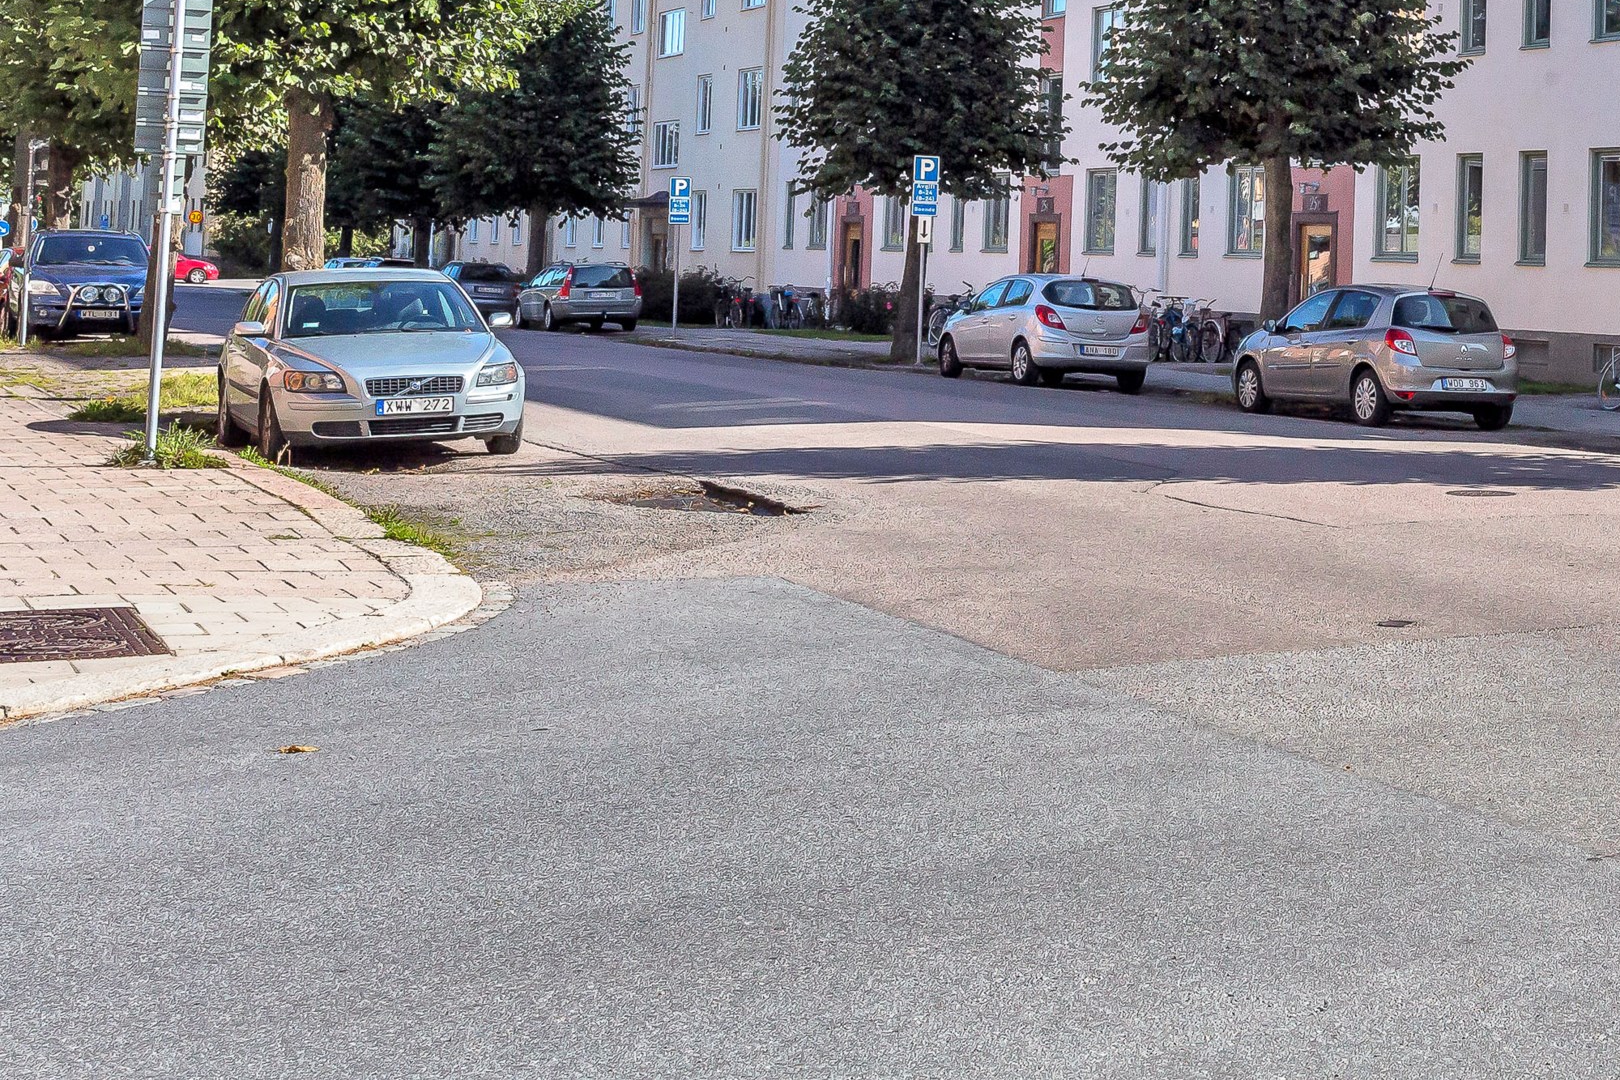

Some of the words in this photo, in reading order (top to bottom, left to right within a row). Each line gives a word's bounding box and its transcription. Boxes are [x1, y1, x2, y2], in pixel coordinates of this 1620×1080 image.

[920, 158, 935, 180] P
[1468, 379, 1485, 388] 963
[386, 400, 413, 413] XWW
[423, 398, 450, 411] 272
